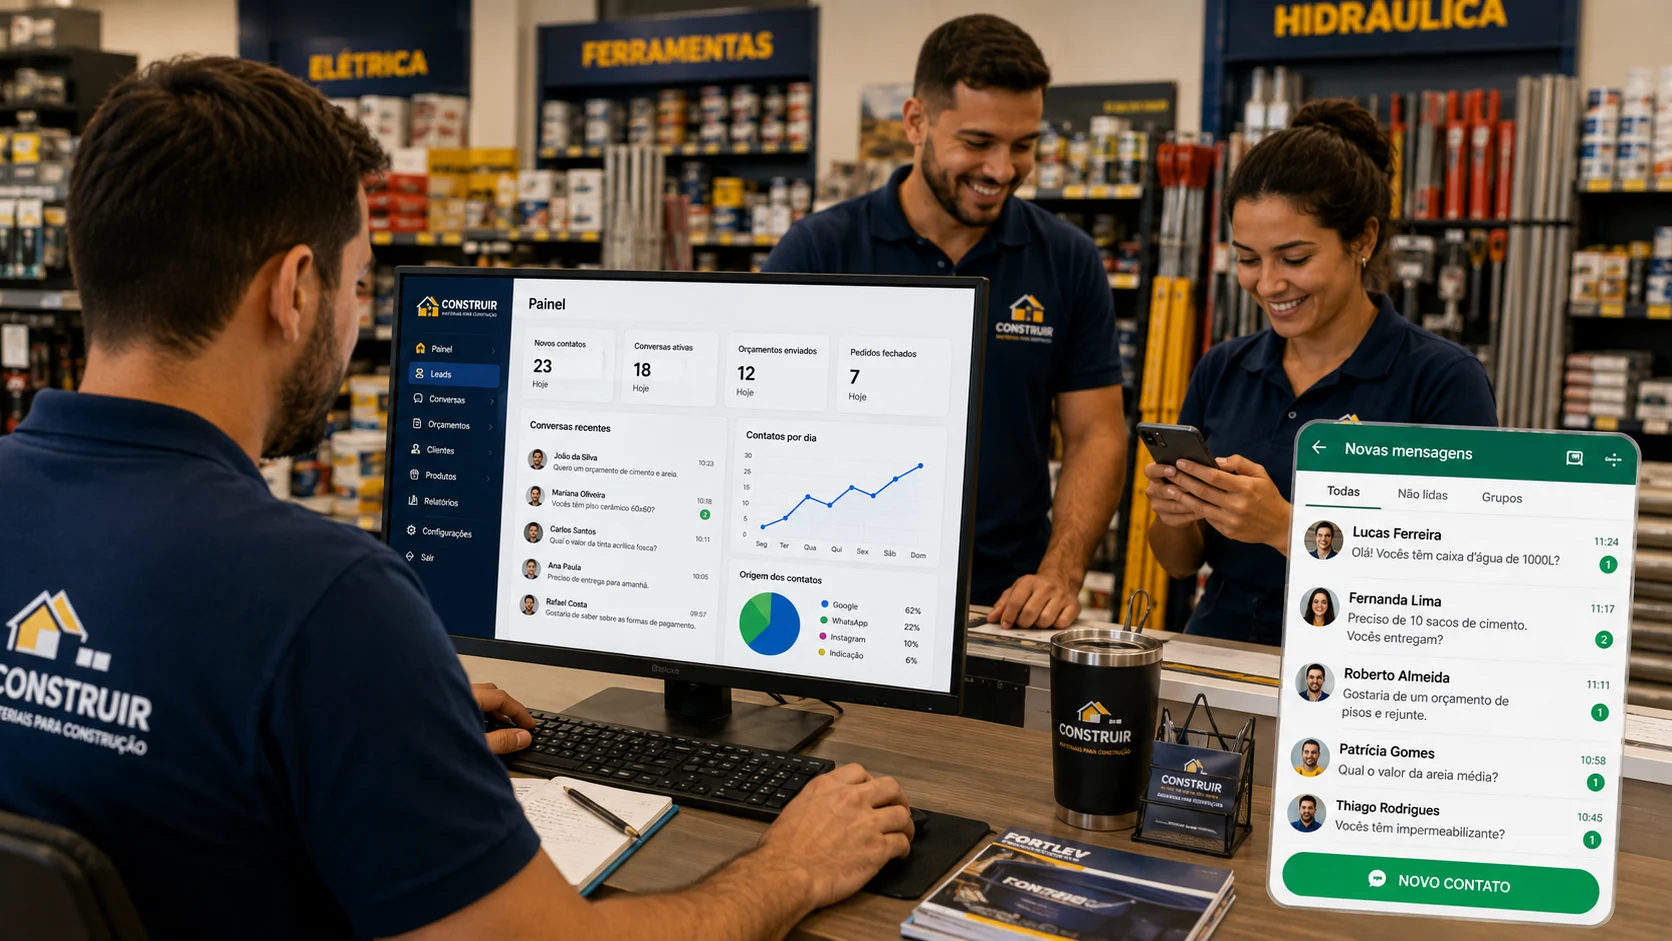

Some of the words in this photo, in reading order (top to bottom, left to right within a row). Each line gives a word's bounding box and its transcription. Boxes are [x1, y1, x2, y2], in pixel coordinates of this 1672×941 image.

[582, 32, 774, 68] FERRAMENTAS
[309, 48, 429, 81] ELÉTRICA
[442, 299, 498, 310] CONSTRUIR
[529, 297, 565, 310] Painel
[995, 322, 1054, 337] CONSTRUIR
[534, 339, 555, 347] Novos
[634, 342, 670, 350] Conversas
[672, 343, 693, 351] ativas
[432, 345, 452, 353] Painel
[738, 344, 782, 354] Orçamentos
[784, 346, 816, 354] enviados
[850, 348, 880, 356] Pedidos
[882, 349, 916, 357] fechados
[533, 358, 551, 373] 23
[634, 362, 650, 376] 18
[430, 370, 451, 378] Leads
[738, 365, 754, 380] 12
[850, 369, 859, 384] 7
[532, 380, 548, 389] Hoje
[632, 384, 649, 393] Hoje
[736, 388, 754, 397] Hoje
[848, 392, 866, 402] Hoje
[429, 394, 465, 404] Conversas
[428, 420, 470, 429] Orçamentos
[530, 420, 572, 430] Conversas
[574, 424, 610, 432] recentes
[746, 430, 785, 440] Contatos
[787, 434, 801, 442] por
[804, 433, 816, 442] dia
[426, 445, 454, 454] Clientes
[1345, 442, 1388, 456] Novas
[1392, 447, 1472, 461] mensagens
[581, 453, 597, 461] Silva
[553, 463, 572, 471] Quero
[584, 466, 618, 474] orçamento
[698, 459, 714, 467] 10:23
[426, 471, 456, 480] Produtos
[552, 489, 578, 497] Mariana
[1327, 485, 1359, 496] Todas
[1398, 488, 1419, 499] Não
[1423, 489, 1447, 500] lidas
[424, 497, 458, 506] Relatórios
[1482, 492, 1522, 504] Grupos
[550, 524, 571, 533] Carlos
[573, 526, 596, 535] Santos
[1353, 525, 1389, 538] Lucas
[1393, 527, 1441, 540] Ferreira
[756, 540, 767, 548] Seg
[1594, 537, 1618, 546] 11:24
[1352, 547, 1373, 557] Olá!
[1376, 548, 1409, 559] Vocês
[1412, 549, 1432, 560] têm
[1436, 550, 1463, 561] caixa
[1506, 553, 1519, 564] de
[1523, 554, 1560, 565] 1000L?
[548, 561, 561, 569] Ana
[562, 562, 581, 571] Paula
[1606, 560, 1610, 569] 1
[739, 570, 768, 581] Origem
[770, 572, 784, 581] dos
[786, 575, 822, 584] contatos
[546, 597, 566, 606] Rafael
[568, 599, 587, 608] Costa
[1349, 591, 1407, 605] Fernanda
[1411, 594, 1441, 607] Lima
[833, 601, 858, 611] Google
[905, 606, 921, 614] 62%
[1591, 604, 1614, 613] 11:17
[626, 616, 648, 625] formas
[658, 620, 695, 629] pagamento.
[832, 617, 868, 627] WhatsApp
[1348, 612, 1389, 624] Preciso
[1392, 614, 1406, 625] de
[1410, 615, 1422, 626] 10
[1426, 618, 1458, 627] sacos
[1462, 617, 1476, 628] de
[1479, 618, 1527, 630] cimento.
[904, 623, 920, 631] 22%
[830, 633, 865, 644] Instagram
[904, 639, 918, 647] 10%
[1347, 630, 1380, 642] Vocês
[1383, 633, 1443, 646] entregam?
[1601, 635, 1607, 644] 2
[830, 649, 863, 660] Indicação
[905, 656, 917, 664] 6%
[1344, 667, 1394, 680] Roberto
[1398, 670, 1449, 683] Almeida
[1587, 680, 1609, 689] 11:11
[1343, 688, 1389, 700] Gostaria
[1392, 690, 1407, 701] de
[1410, 694, 1427, 702] um
[1431, 694, 1491, 706] orçamento
[1494, 695, 1508, 706] de
[1342, 706, 1371, 718] pisos
[1374, 710, 1381, 718] e
[1385, 708, 1426, 721] rejunte.
[1597, 708, 1601, 717] 1
[33, 714, 62, 735] PARA
[63, 722, 148, 756] CONSTRUÇÃO
[1059, 722, 1132, 744] CONSTRUIR
[1340, 743, 1386, 756] Patrícia
[1390, 745, 1434, 759] Gomes
[1581, 755, 1606, 765] 10:58
[1338, 764, 1364, 775] Qual
[1367, 768, 1374, 776] o
[1378, 766, 1405, 777] valor
[1408, 768, 1422, 778] da
[1426, 769, 1453, 780] areia
[1457, 770, 1498, 782] média?
[1161, 774, 1222, 793] CONSTRUIR
[1593, 778, 1597, 786] 1
[1336, 799, 1376, 814] Thiago
[1380, 802, 1439, 817] Rodrigues
[1578, 812, 1602, 822] 10:45
[1335, 819, 1368, 832] Vocês
[1372, 822, 1392, 833] têm
[1396, 823, 1505, 839] impermeabilizante?
[1590, 835, 1594, 844] 1
[1004, 832, 1091, 859] FORTLEV
[1399, 874, 1439, 888] NOVO
[1444, 877, 1510, 892] CONTATO
